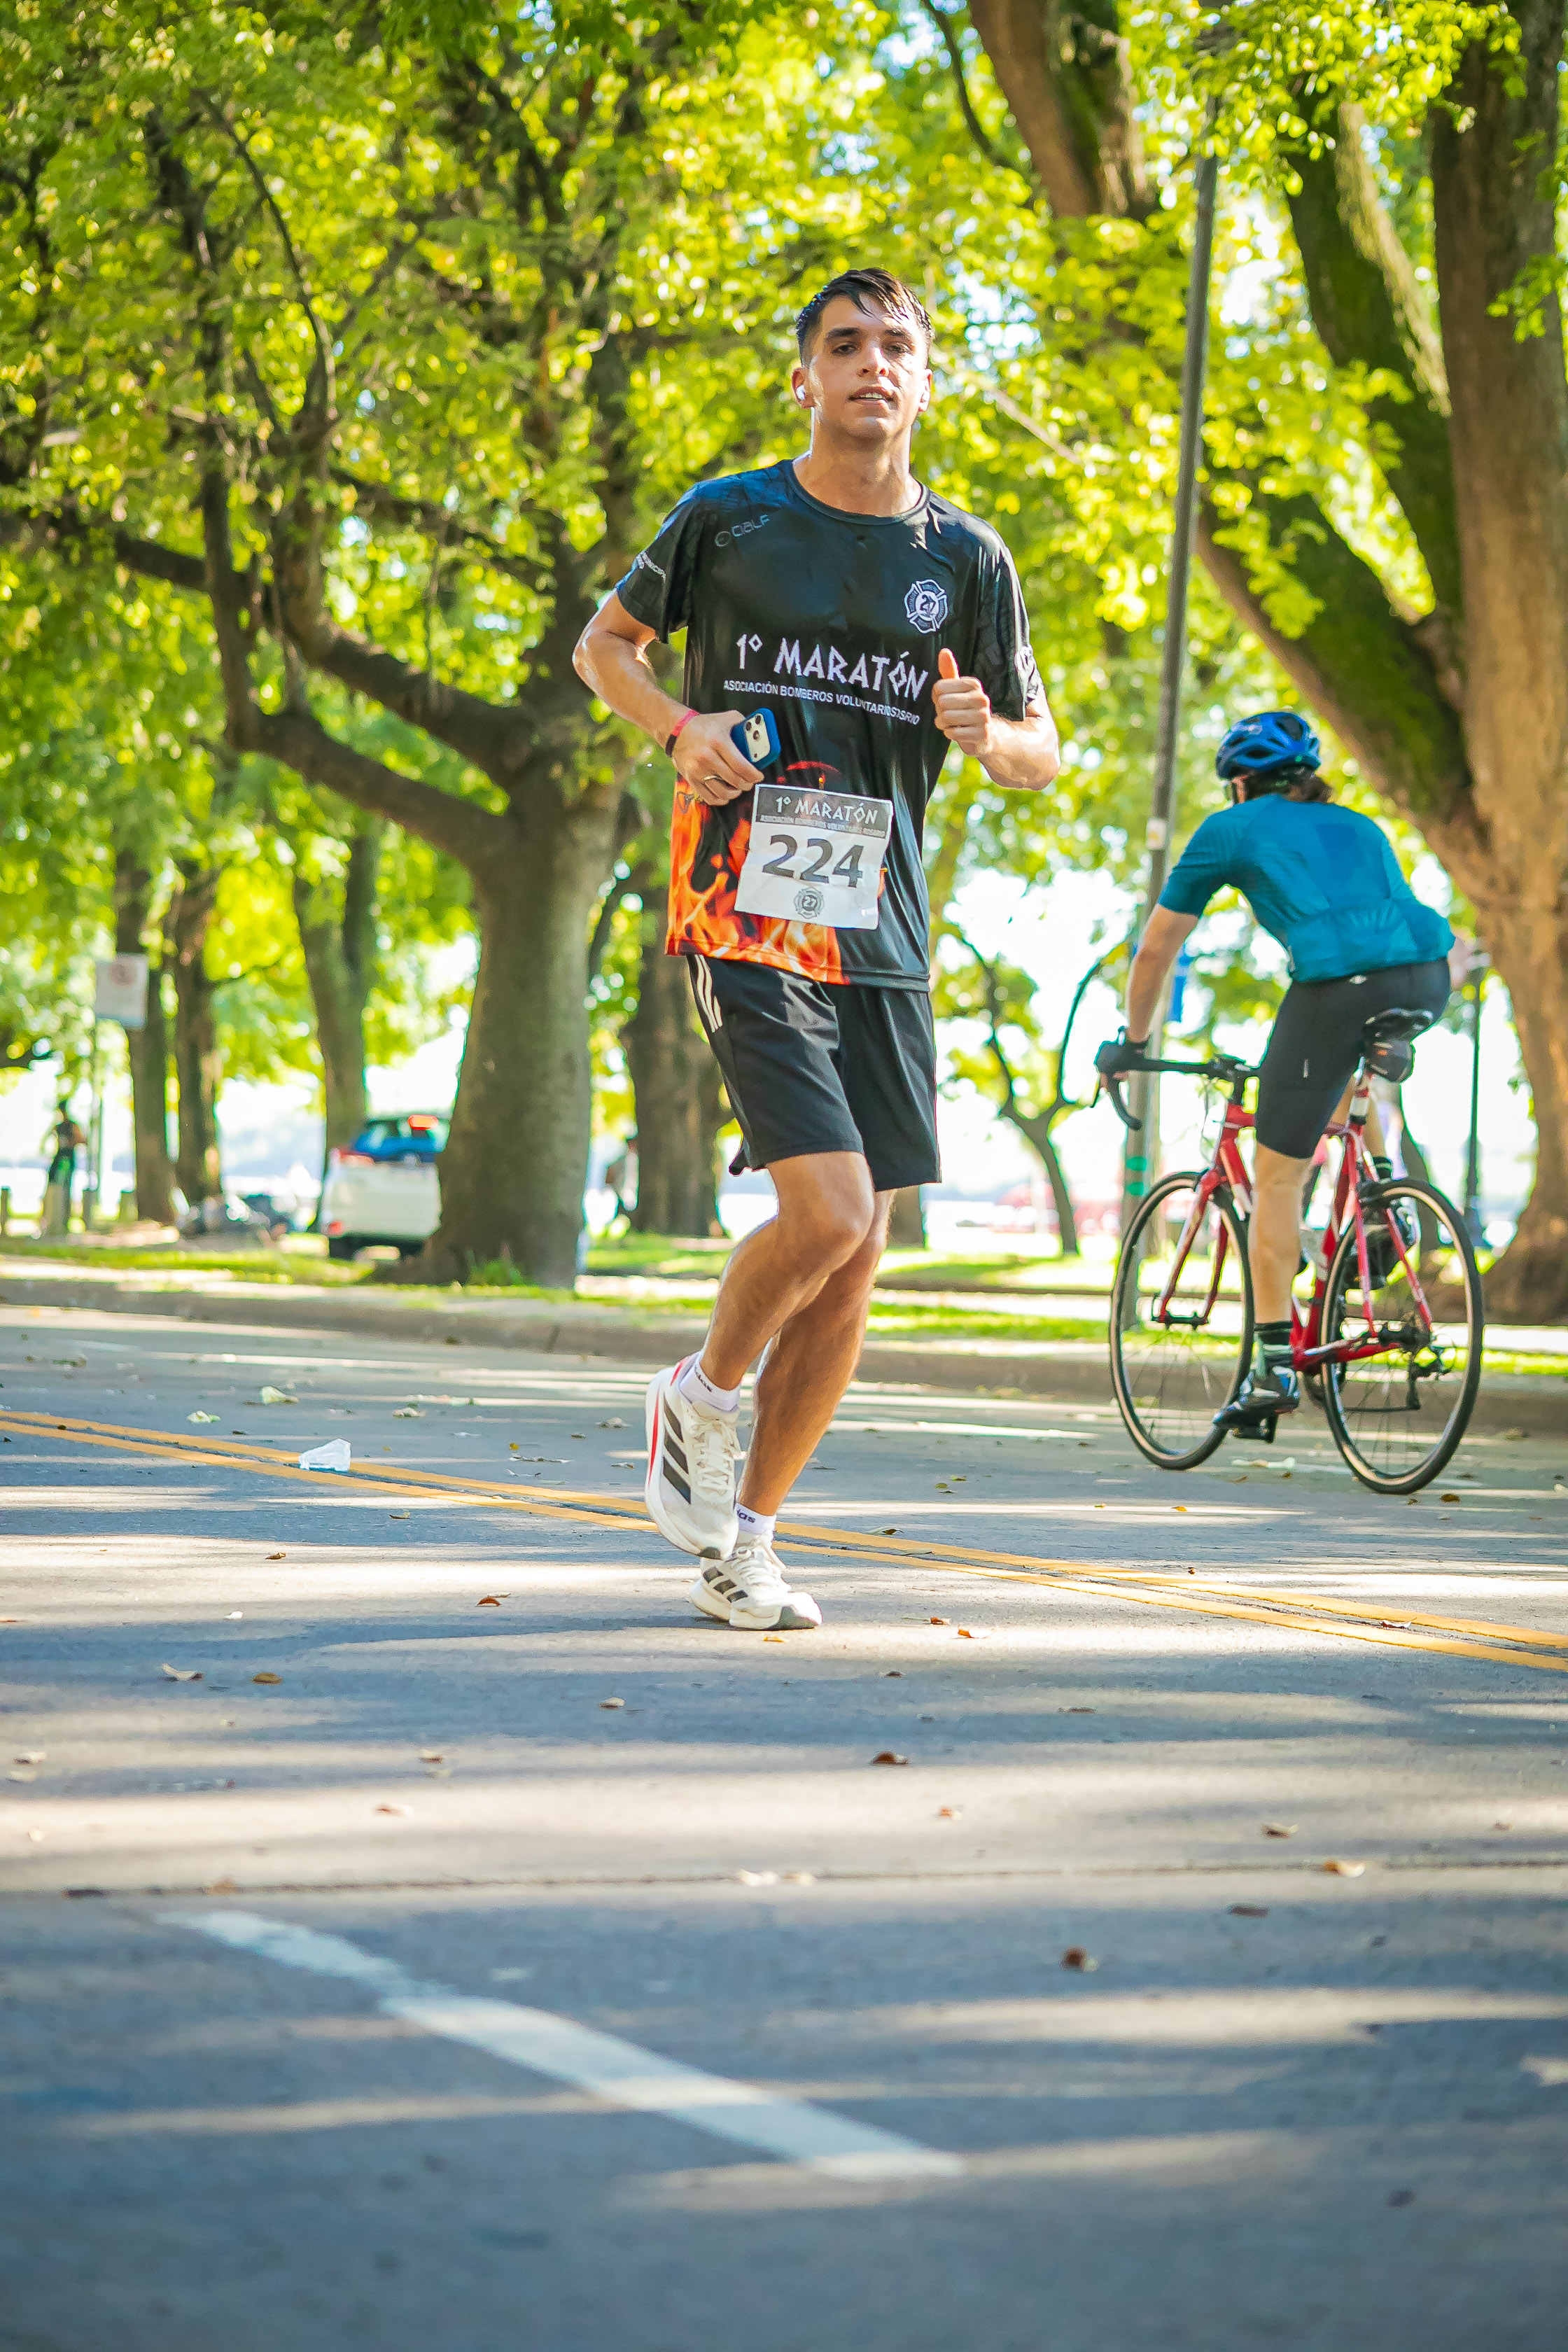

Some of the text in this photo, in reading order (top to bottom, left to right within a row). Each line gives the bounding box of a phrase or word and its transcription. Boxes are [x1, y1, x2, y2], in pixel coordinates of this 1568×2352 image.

[774, 638, 929, 701] MARATÓN
[723, 680, 778, 695] ASOCIACIÓN
[780, 685, 833, 703] BOMBEROS
[794, 797, 878, 825] MARATÓN
[762, 834, 864, 888] 224
